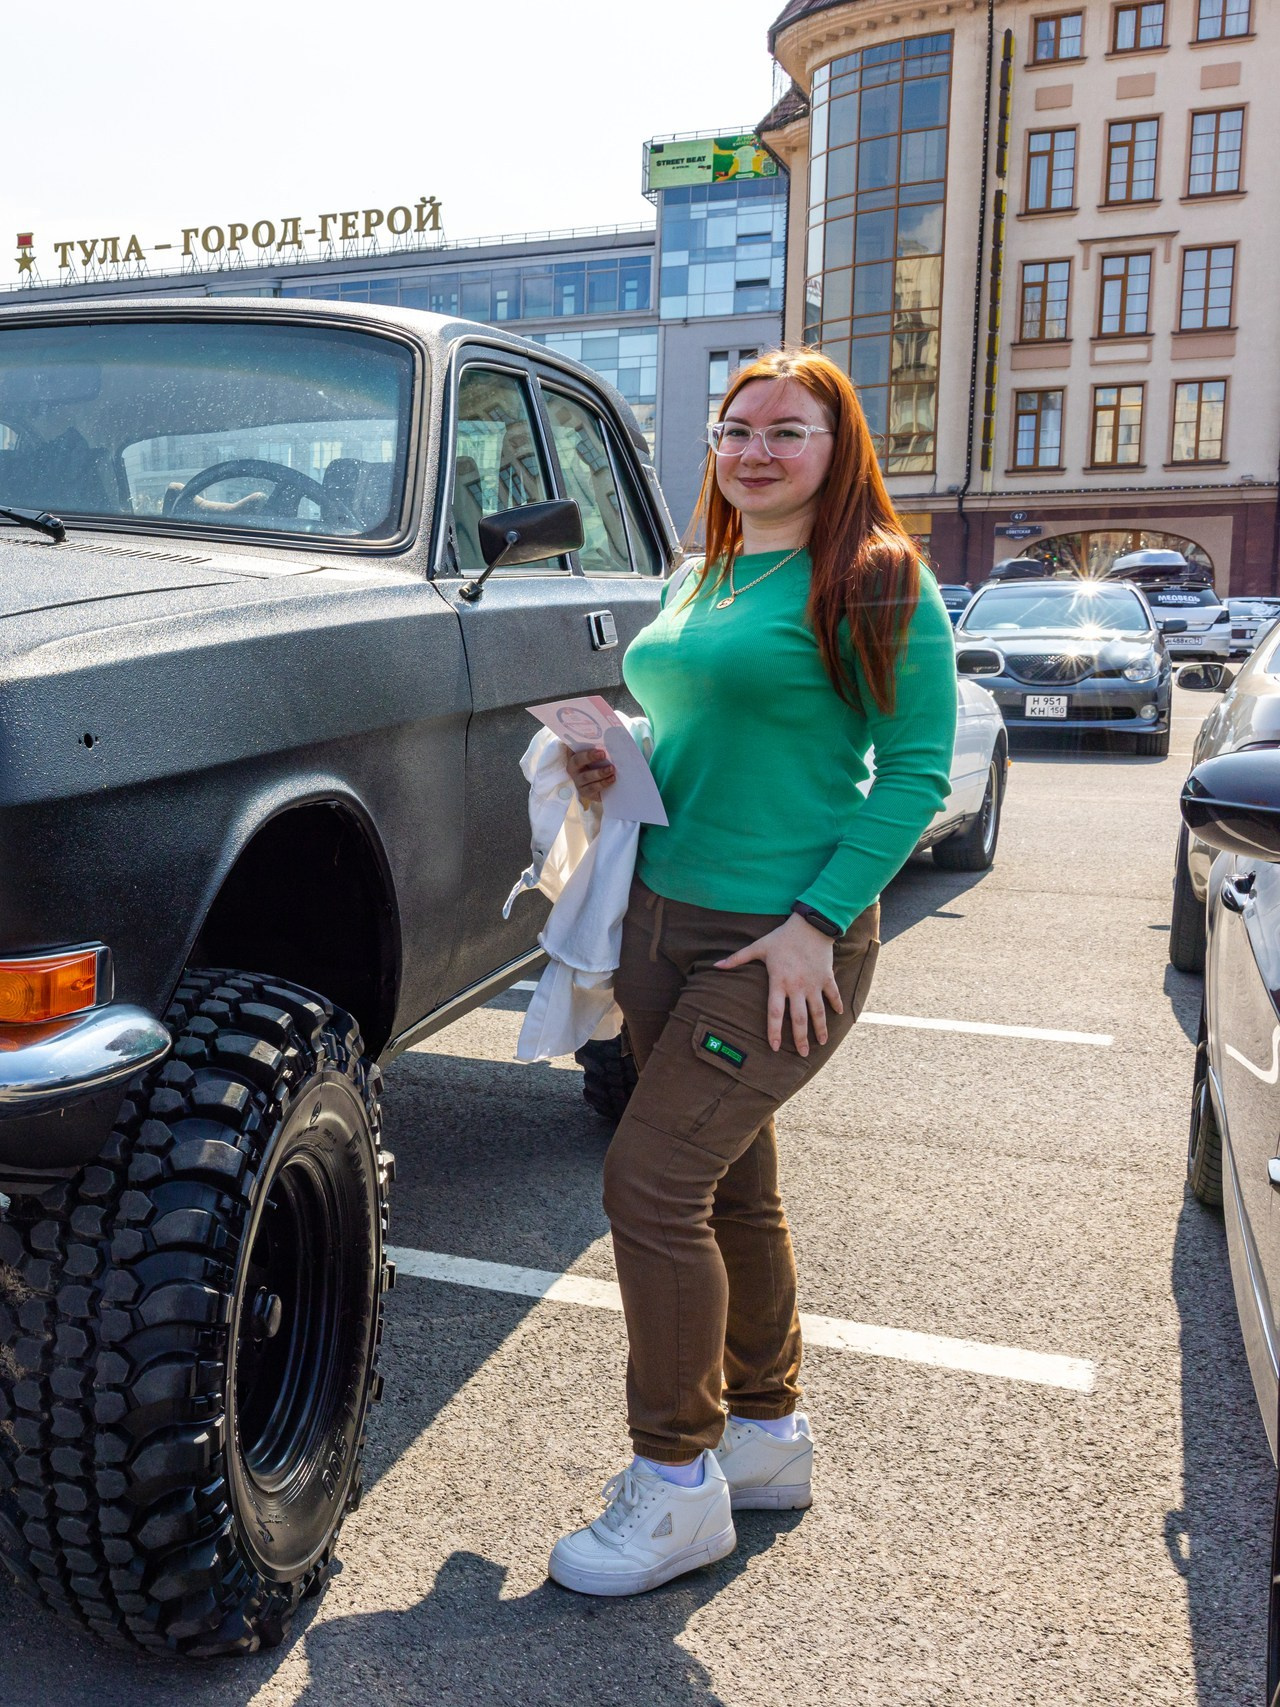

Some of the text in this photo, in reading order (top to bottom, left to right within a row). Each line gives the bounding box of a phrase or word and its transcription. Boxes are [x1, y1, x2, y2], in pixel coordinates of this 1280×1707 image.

[656, 156, 706, 167] STREET BEAT
[54, 234, 145, 268] ТУЛА
[181, 196, 442, 255] ГОРОД-ГЕРОЙ
[1032, 697, 1061, 705] Н 951
[1030, 707, 1045, 715] КН
